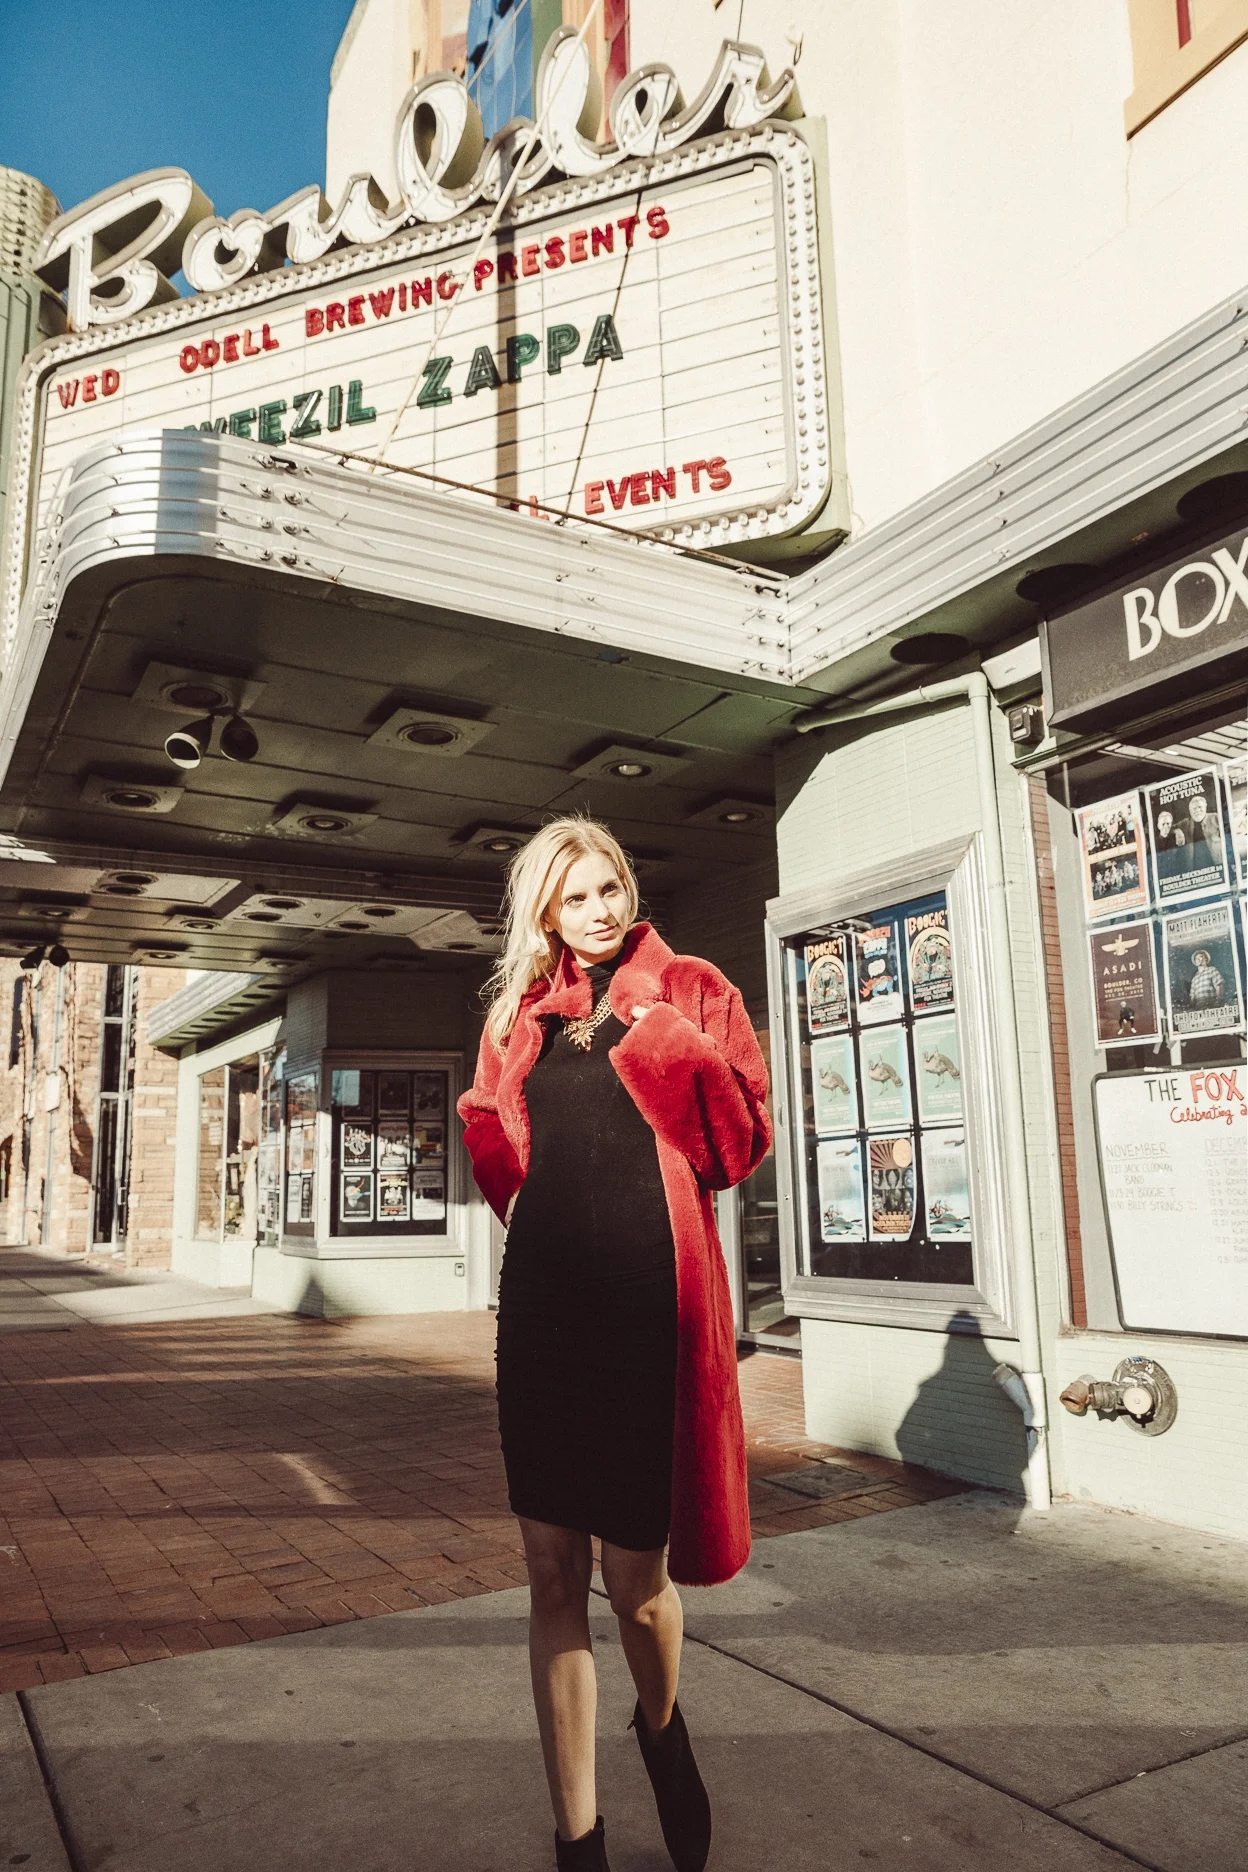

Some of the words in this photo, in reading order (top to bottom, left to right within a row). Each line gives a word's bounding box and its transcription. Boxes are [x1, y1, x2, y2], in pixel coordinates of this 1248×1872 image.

[36, 24, 794, 332] Boulder
[180, 323, 279, 374] ODELL
[305, 271, 463, 338] BREWING
[473, 206, 670, 292] PRESENTS
[417, 314, 624, 409] ZAPPA
[57, 368, 120, 409] WED
[584, 456, 732, 515] EVENTS
[1123, 527, 1247, 661] BOX
[1159, 776, 1203, 797] ACOUSTIC
[1159, 792, 1178, 805] HOT
[1179, 785, 1205, 799] TUNA
[908, 910, 946, 937] BOOGIE
[1169, 921, 1188, 934] MATT
[1191, 911, 1227, 930] FLAHERTY
[1103, 960, 1142, 976] ASADI
[1174, 1014, 1188, 1024] THE
[1205, 1005, 1239, 1019] THEATRE
[1143, 1079, 1181, 1102] THE
[1189, 1069, 1245, 1103] FOX
[1170, 1105, 1235, 1125] Celebrating
[1105, 1142, 1169, 1158] NOVEMBER
[1137, 1187, 1165, 1198] BOOGIE
[1127, 1199, 1146, 1211] BILLY
[1149, 1200, 1184, 1212] STRINGS
